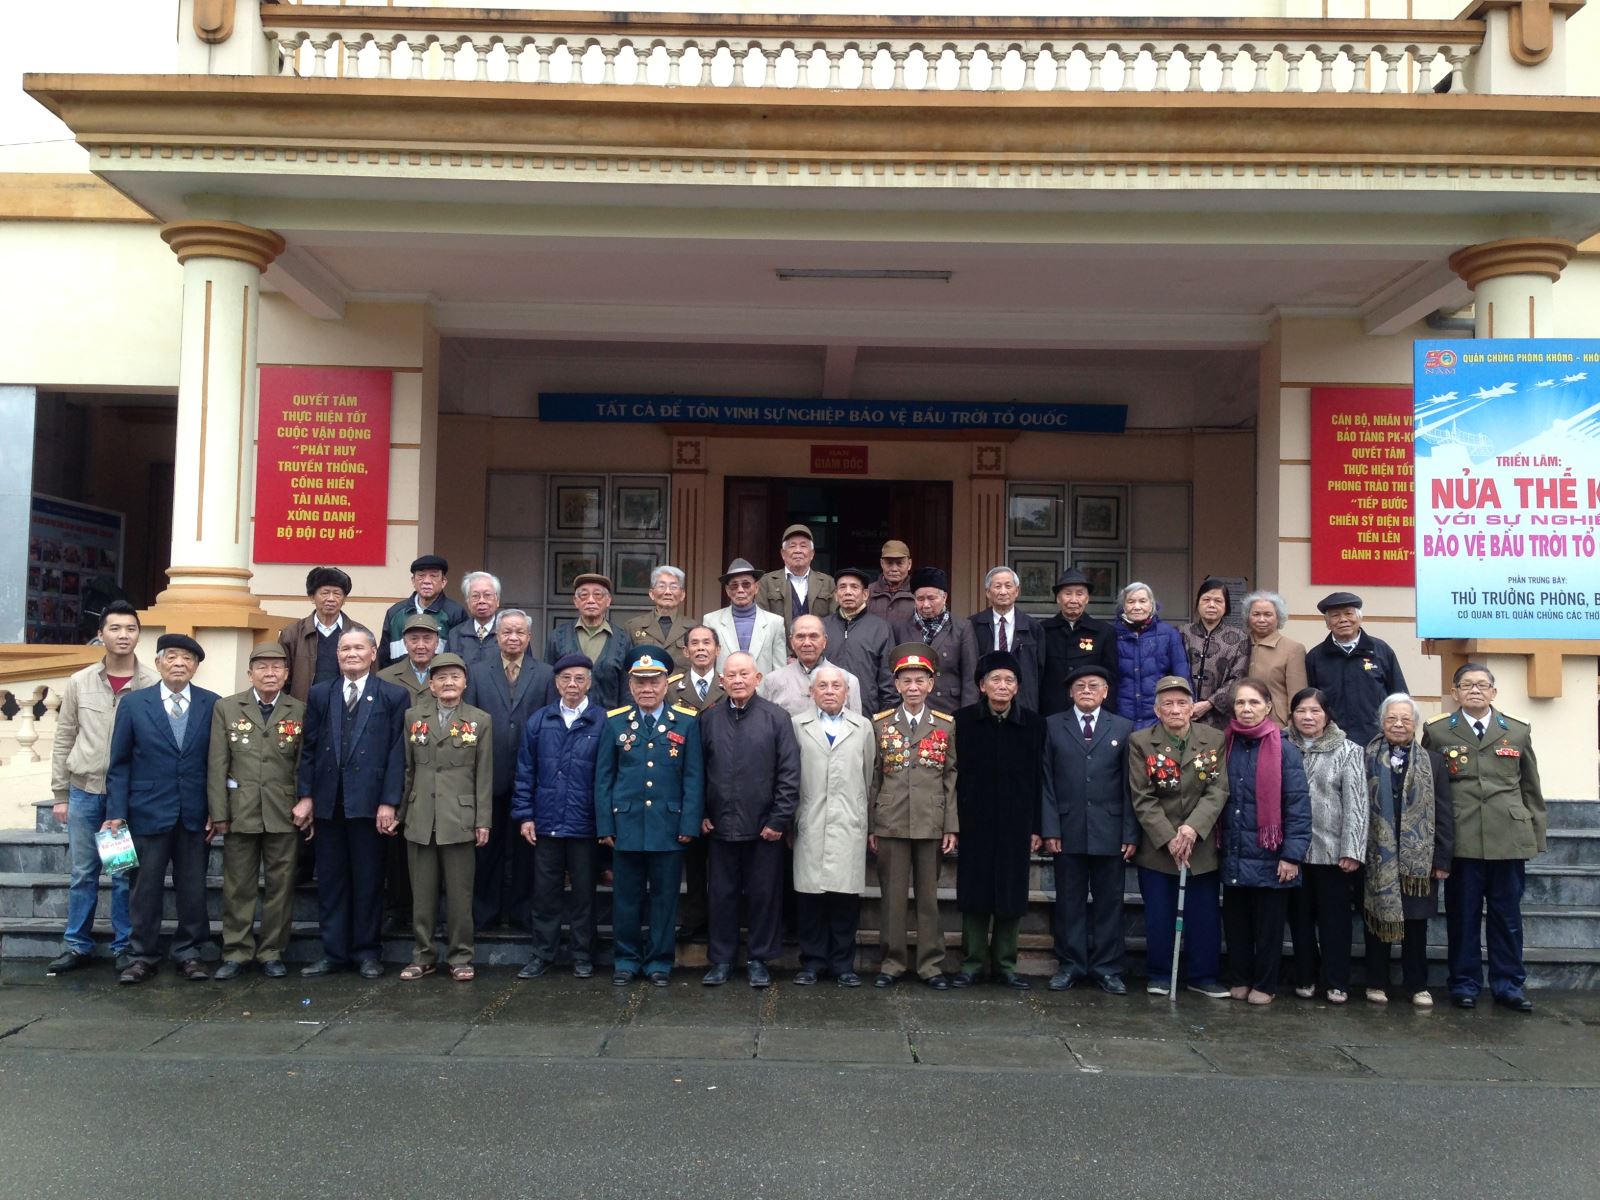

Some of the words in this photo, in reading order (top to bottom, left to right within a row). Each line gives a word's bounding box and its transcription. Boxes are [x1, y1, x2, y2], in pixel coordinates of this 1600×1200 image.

[1463, 352, 1484, 363] QUÂN
[1546, 352, 1573, 362] KHÔNG
[292, 392, 330, 406] QUYẾT
[333, 394, 358, 406] TÂM
[282, 410, 312, 424] THỰC
[316, 410, 342, 424] HIỆN
[346, 410, 367, 423] TỐT
[596, 400, 627, 416] TẤT
[632, 400, 656, 416] CẢ
[687, 402, 719, 418] TÔN
[724, 407, 759, 420] VINH
[764, 407, 784, 424] SỰ
[788, 406, 844, 424] NGHIỆP
[850, 406, 884, 422] BẢO
[889, 408, 908, 426] VỆ
[950, 408, 988, 424] TRỜI
[992, 406, 1015, 424] TỔ
[1020, 409, 1068, 426] QUỐC
[1332, 413, 1351, 426] CÁN
[1373, 414, 1400, 426] NHÂN
[1404, 416, 1414, 426] VI
[278, 426, 308, 440] CUỘC
[312, 426, 336, 440] VẬN
[339, 427, 371, 441] ĐỘNG
[1336, 427, 1356, 442] BẢO
[1359, 430, 1384, 442] TÀNG
[334, 446, 356, 456] HUY
[1352, 445, 1382, 459] QUYẾT
[1384, 446, 1406, 458] TÂM
[1496, 452, 1530, 467] TRIỂN
[1534, 454, 1562, 467] LÃM:
[1344, 464, 1368, 476] THỰC
[1371, 463, 1394, 477] HIỆN
[1396, 462, 1414, 475] TỐT
[326, 475, 354, 489] HIẾN
[1328, 480, 1362, 492] PHONG
[1364, 478, 1389, 492] TRÀO
[1392, 482, 1406, 492] THI
[1432, 468, 1502, 509] NỬA
[1514, 468, 1578, 509] THẾ
[293, 492, 310, 504] TÀI
[1381, 496, 1408, 510] BƯỚC
[288, 508, 320, 521] XỨNG
[322, 511, 356, 522] DANH
[1329, 512, 1358, 526] CHIẾN
[1376, 514, 1400, 528] ĐIỆN
[1402, 516, 1414, 526] BI
[1434, 512, 1476, 525] VỚI
[1486, 514, 1522, 527] SỰ
[277, 526, 292, 540] BỘ
[296, 526, 316, 540] ĐỘI
[320, 528, 336, 540] CỤ
[1357, 529, 1379, 542] TIẾN
[1382, 530, 1400, 543] LÊN
[1424, 528, 1459, 557] BẢO
[1464, 530, 1486, 561] VỆ
[1490, 529, 1524, 557] BẦU
[1529, 530, 1567, 558] TRỜI
[1572, 527, 1595, 558] TỔ
[1342, 546, 1372, 560] GIÀNH
[1374, 550, 1380, 560] 3
[1451, 587, 1476, 605] THỦ
[1482, 588, 1534, 605] TRƯỞNG
[1471, 610, 1492, 620] QUAN
[1496, 610, 1510, 619] BTL
[1512, 610, 1534, 620] QUÂN
[1566, 610, 1582, 620] CÁC
